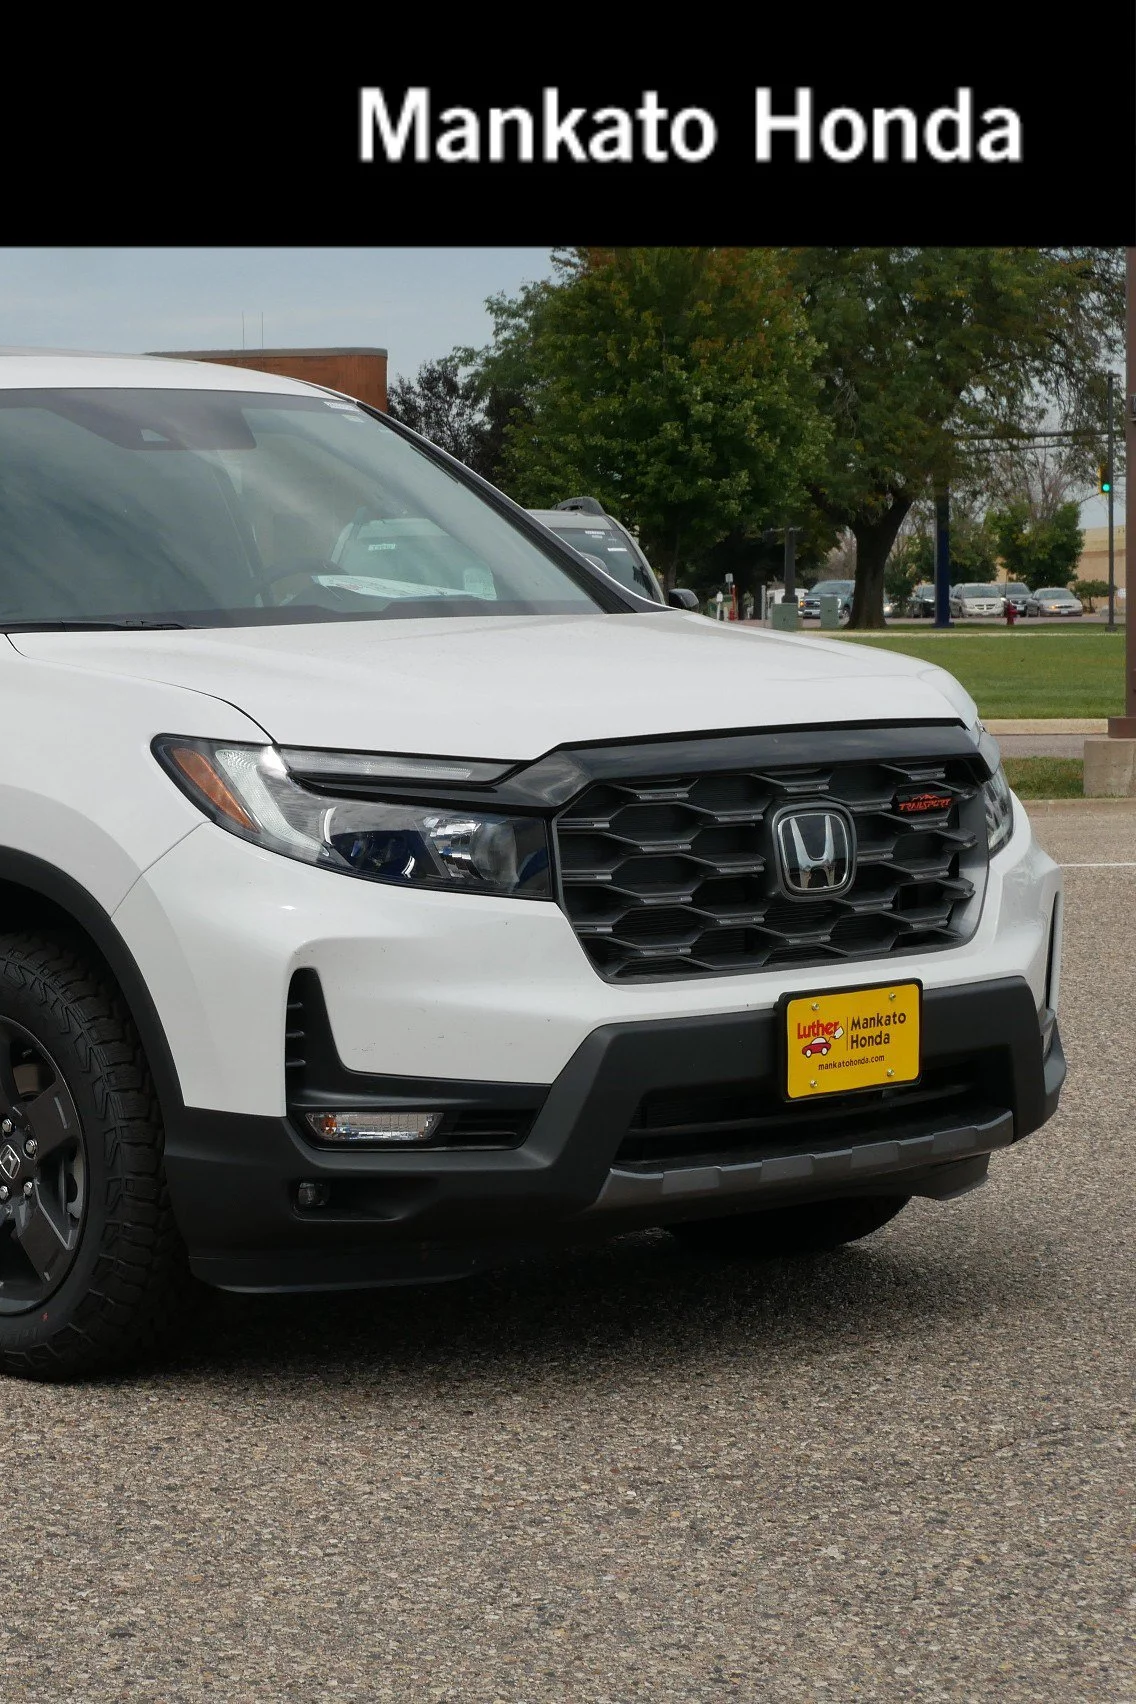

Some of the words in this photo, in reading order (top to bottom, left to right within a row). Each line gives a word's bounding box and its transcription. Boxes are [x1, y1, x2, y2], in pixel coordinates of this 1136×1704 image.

[797, 1020, 840, 1039] Luther
[850, 1012, 907, 1031] Mankato
[850, 1032, 890, 1050] Honda
[818, 1055, 885, 1071] mankatohonda.com
